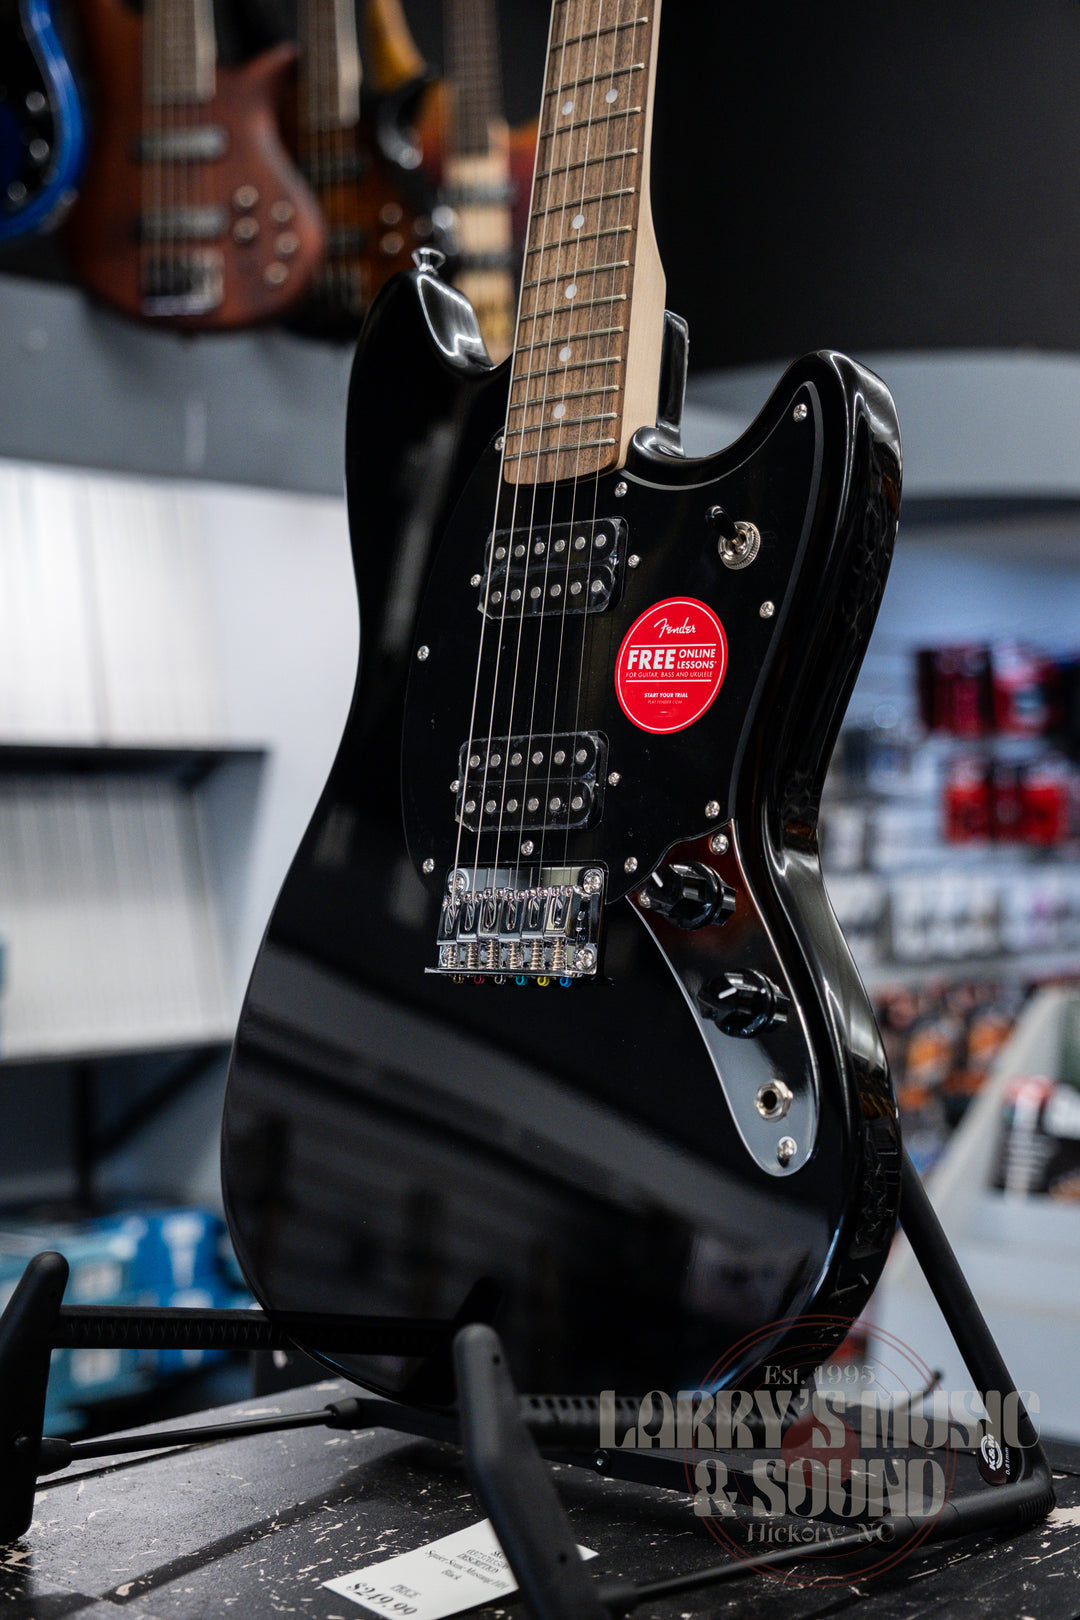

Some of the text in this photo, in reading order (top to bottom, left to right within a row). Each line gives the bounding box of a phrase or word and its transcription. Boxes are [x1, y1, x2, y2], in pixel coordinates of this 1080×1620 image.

[653, 617, 696, 638] Fender
[627, 648, 716, 670] FREE ONLINE
[346, 1582, 418, 1616] $249.99
